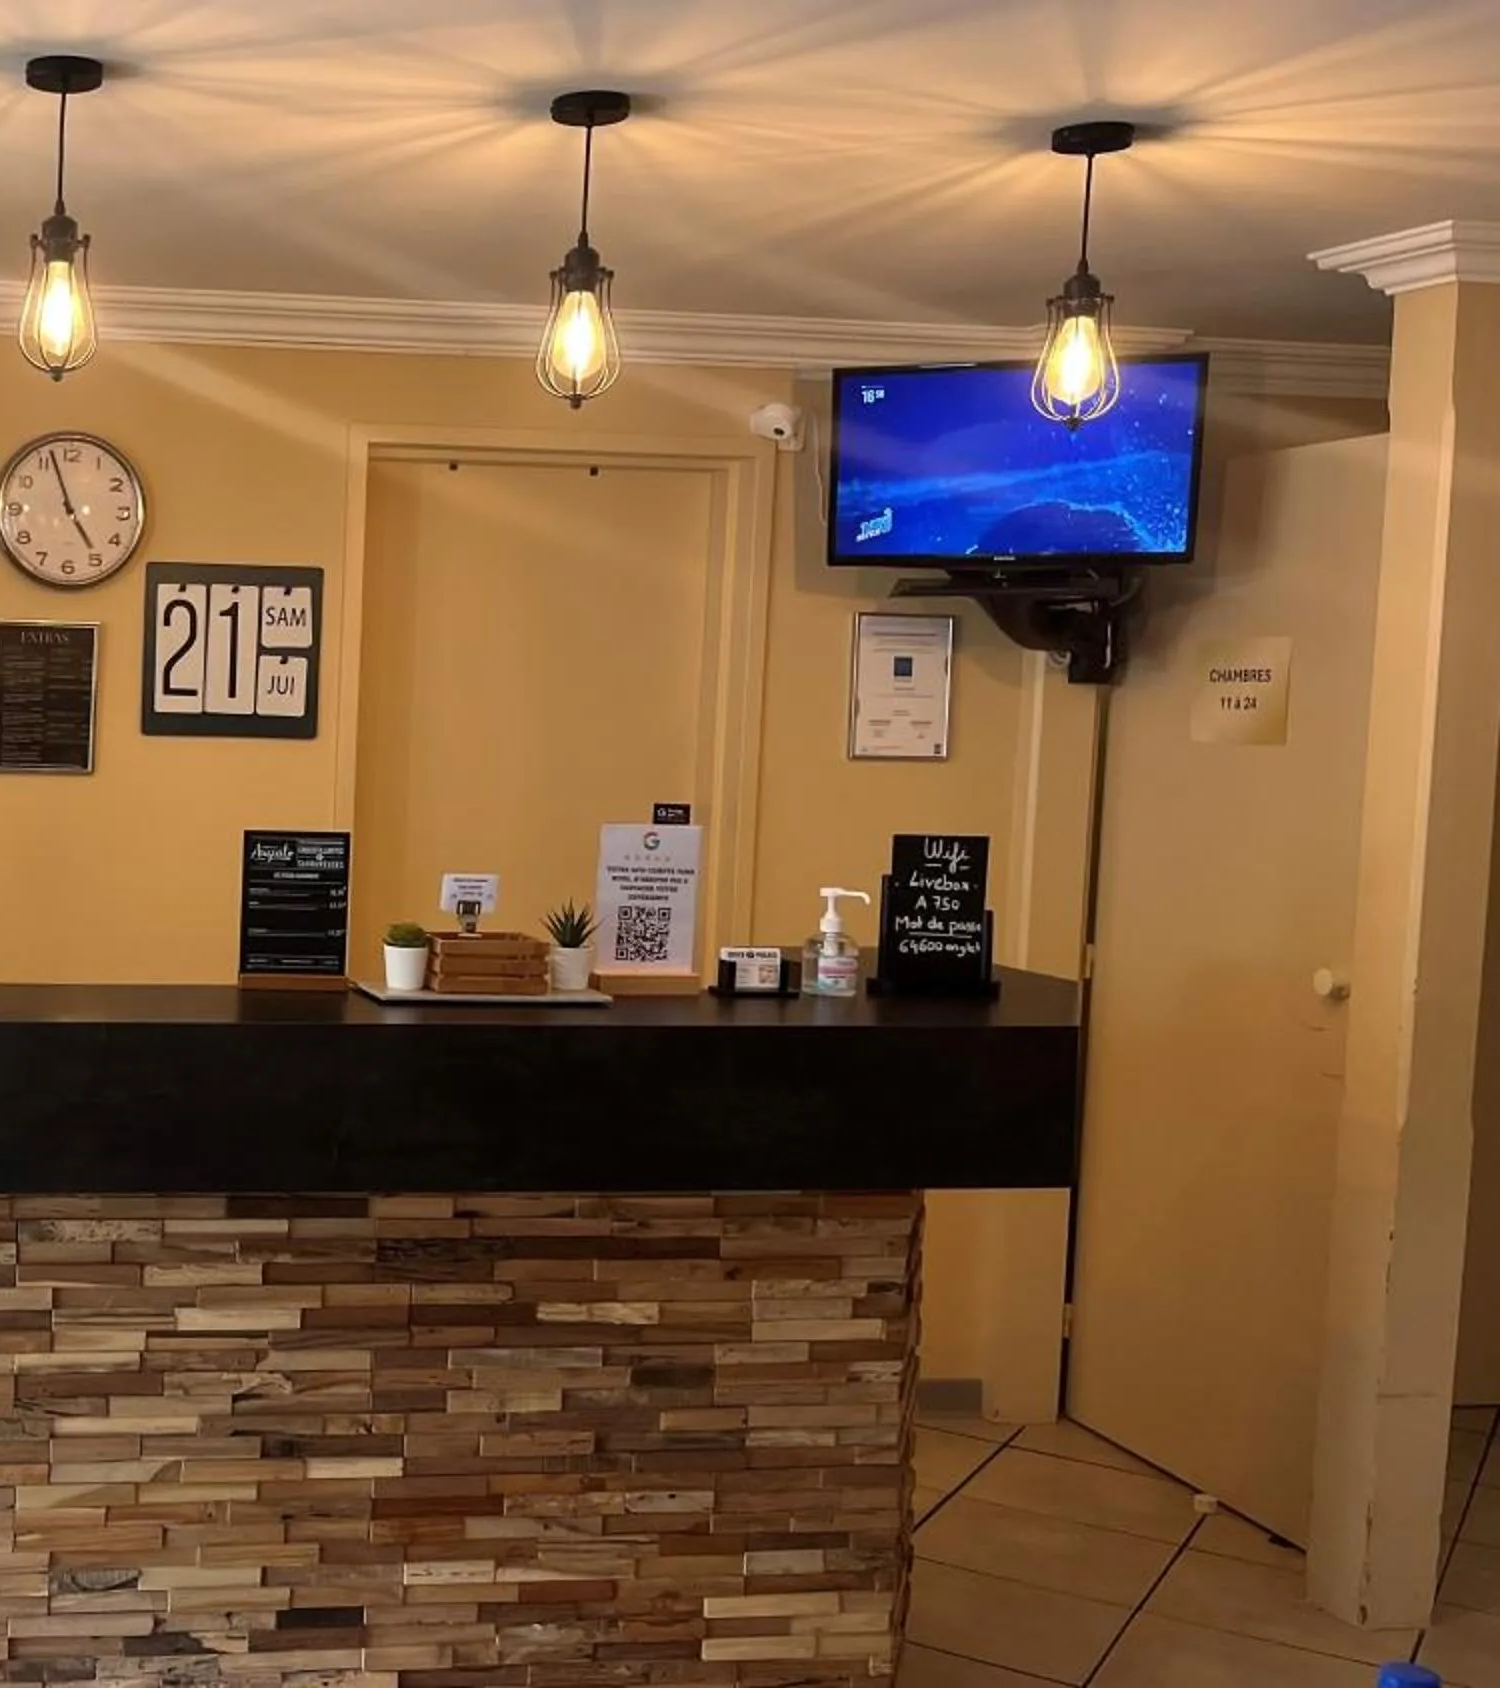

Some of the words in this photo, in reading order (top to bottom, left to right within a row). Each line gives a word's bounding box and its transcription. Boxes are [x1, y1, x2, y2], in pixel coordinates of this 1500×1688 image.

[63, 448, 81, 463] 12
[39, 456, 49, 471] 11
[96, 456, 102, 471] 1
[18, 475, 34, 489] 10
[109, 477, 123, 493] 2
[7, 502, 23, 517] 9
[116, 506, 131, 521] 3
[16, 530, 32, 545] 8
[107, 533, 121, 547] 4
[35, 551, 49, 567] 7
[88, 553, 103, 567] 5
[61, 560, 76, 575] 6
[265, 606, 307, 627] SAM
[266, 675, 296, 695] JUI
[923, 836, 972, 874] Wifi
[914, 895, 927, 910] A
[932, 895, 961, 911] 750
[895, 915, 923, 932] Mot
[927, 916, 945, 931] de
